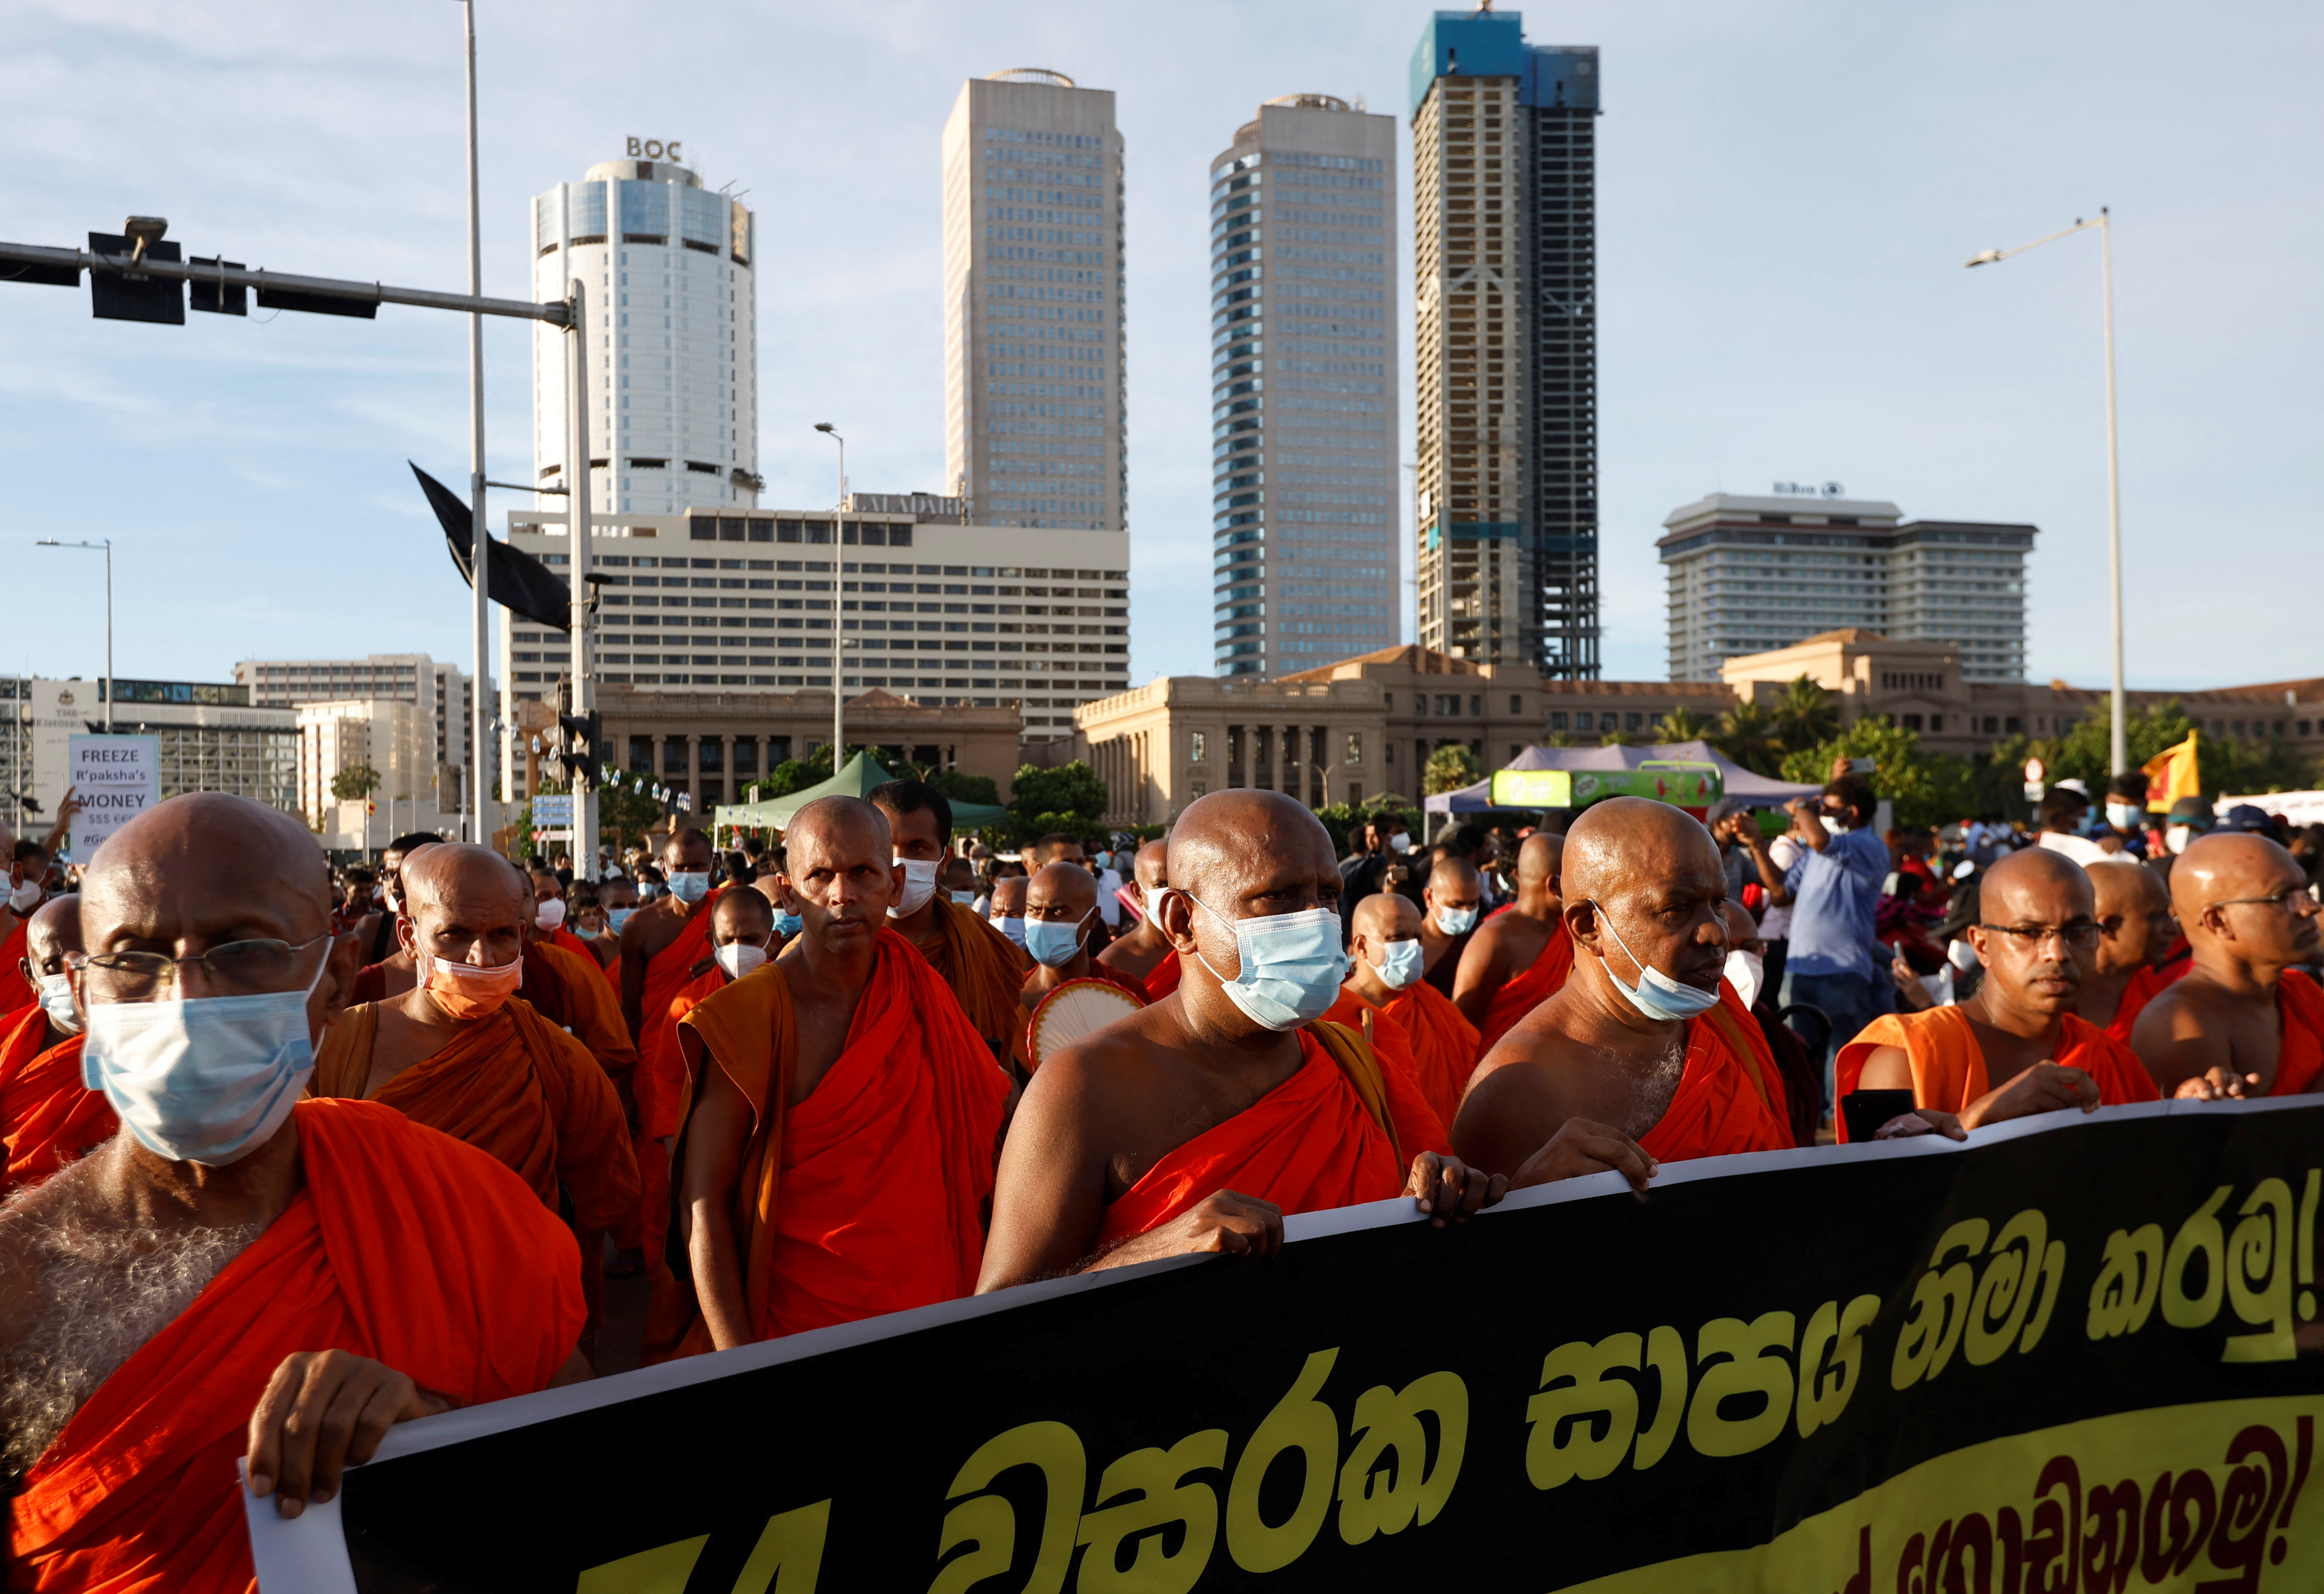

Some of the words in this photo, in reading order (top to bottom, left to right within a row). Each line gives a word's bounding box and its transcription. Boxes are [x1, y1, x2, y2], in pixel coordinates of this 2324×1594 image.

[627, 137, 681, 162] BOC
[82, 750, 138, 762] FREEZE
[76, 770, 145, 783] R'paksha's
[78, 794, 145, 807] MONEY
[89, 813, 110, 824] $$$
[84, 834, 111, 844] #Go
[927, 1347, 1468, 1594] වසරක
[1526, 1295, 1880, 1490] සාපය
[1892, 1210, 2064, 1389] නිමා
[2087, 1168, 2321, 1362] කරමු!
